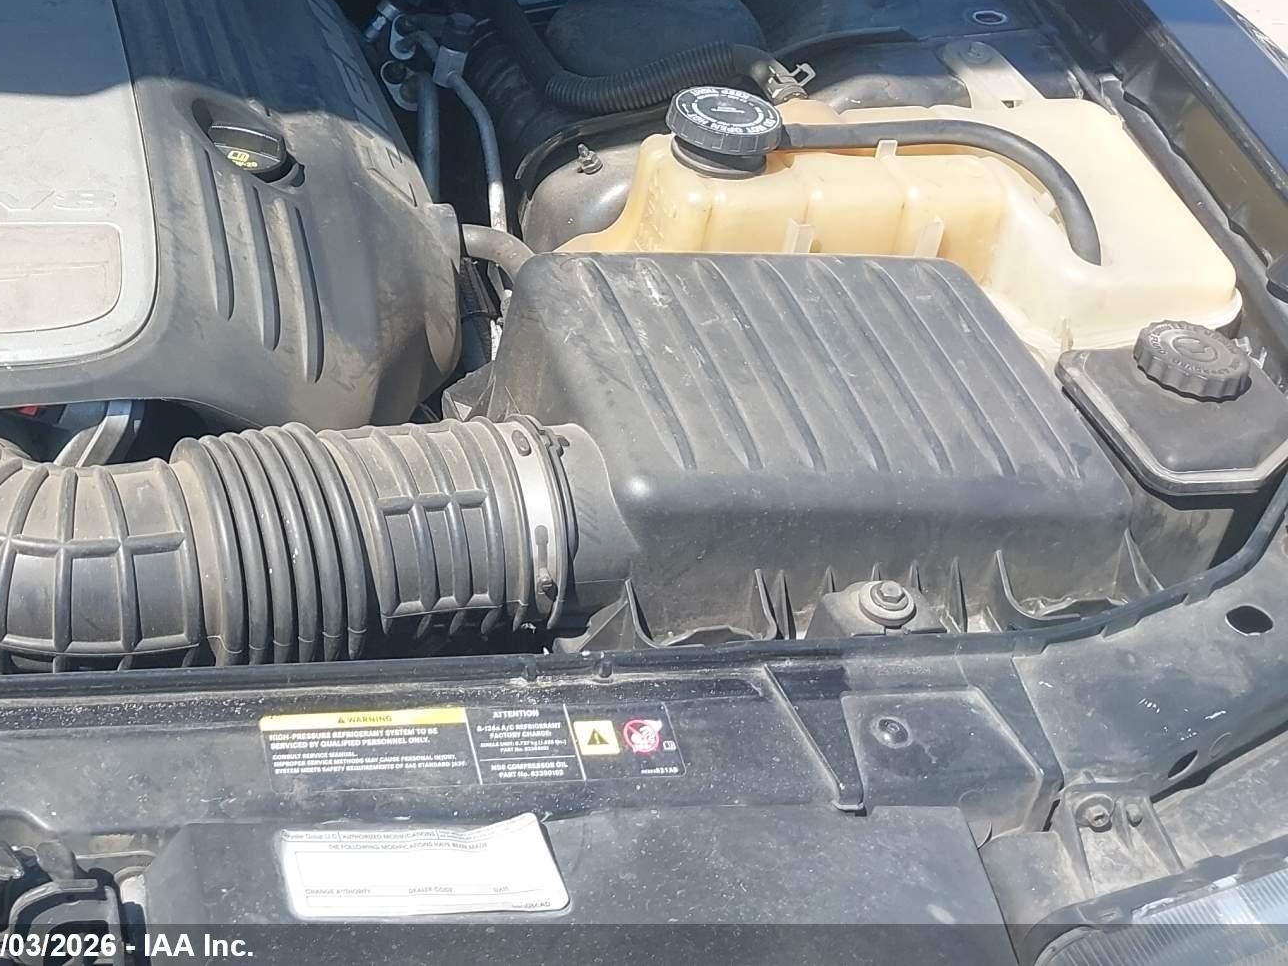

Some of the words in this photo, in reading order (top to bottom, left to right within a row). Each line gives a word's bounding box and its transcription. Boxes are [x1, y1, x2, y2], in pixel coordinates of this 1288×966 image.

[493, 709, 539, 719] ATTENTION
[348, 715, 392, 724] WARNING
[309, 740, 319, 748] BY
[320, 739, 361, 748] QUALIFIED
[362, 737, 407, 746] PERSONNEL
